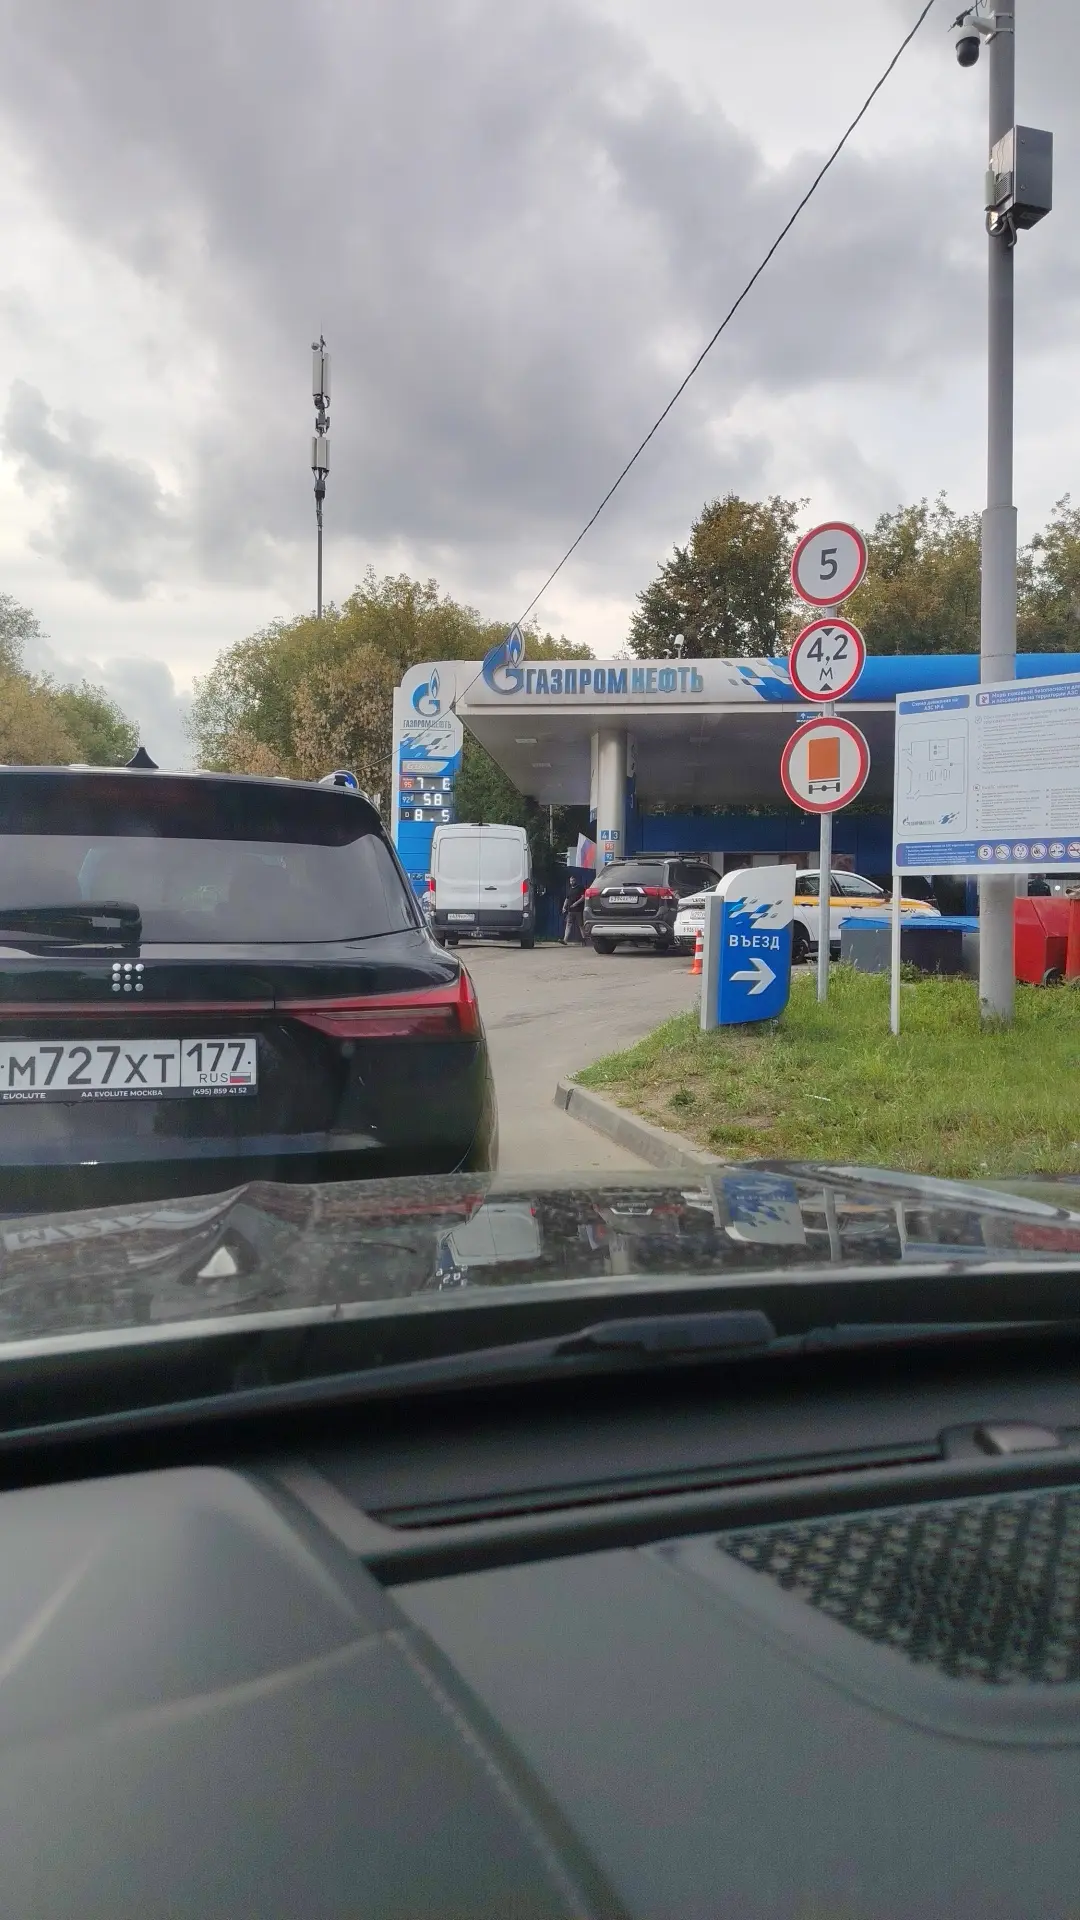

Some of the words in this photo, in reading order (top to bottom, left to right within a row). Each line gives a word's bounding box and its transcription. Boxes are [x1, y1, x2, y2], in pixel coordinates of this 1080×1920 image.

[819, 548, 838, 581] 5
[806, 634, 849, 666] 4,2
[402, 796, 411, 804] 92
[729, 934, 780, 950] ВЪЕЗД
[186, 1042, 246, 1072] 177
[9, 1046, 175, 1087] М727ХТ
[199, 1072, 229, 1084] RUS
[3, 1092, 46, 1100] EVOLUTE
[130, 1089, 163, 1097] МОСКВА
[192, 1087, 212, 1096] (495)
[213, 1087, 228, 1095] 859
